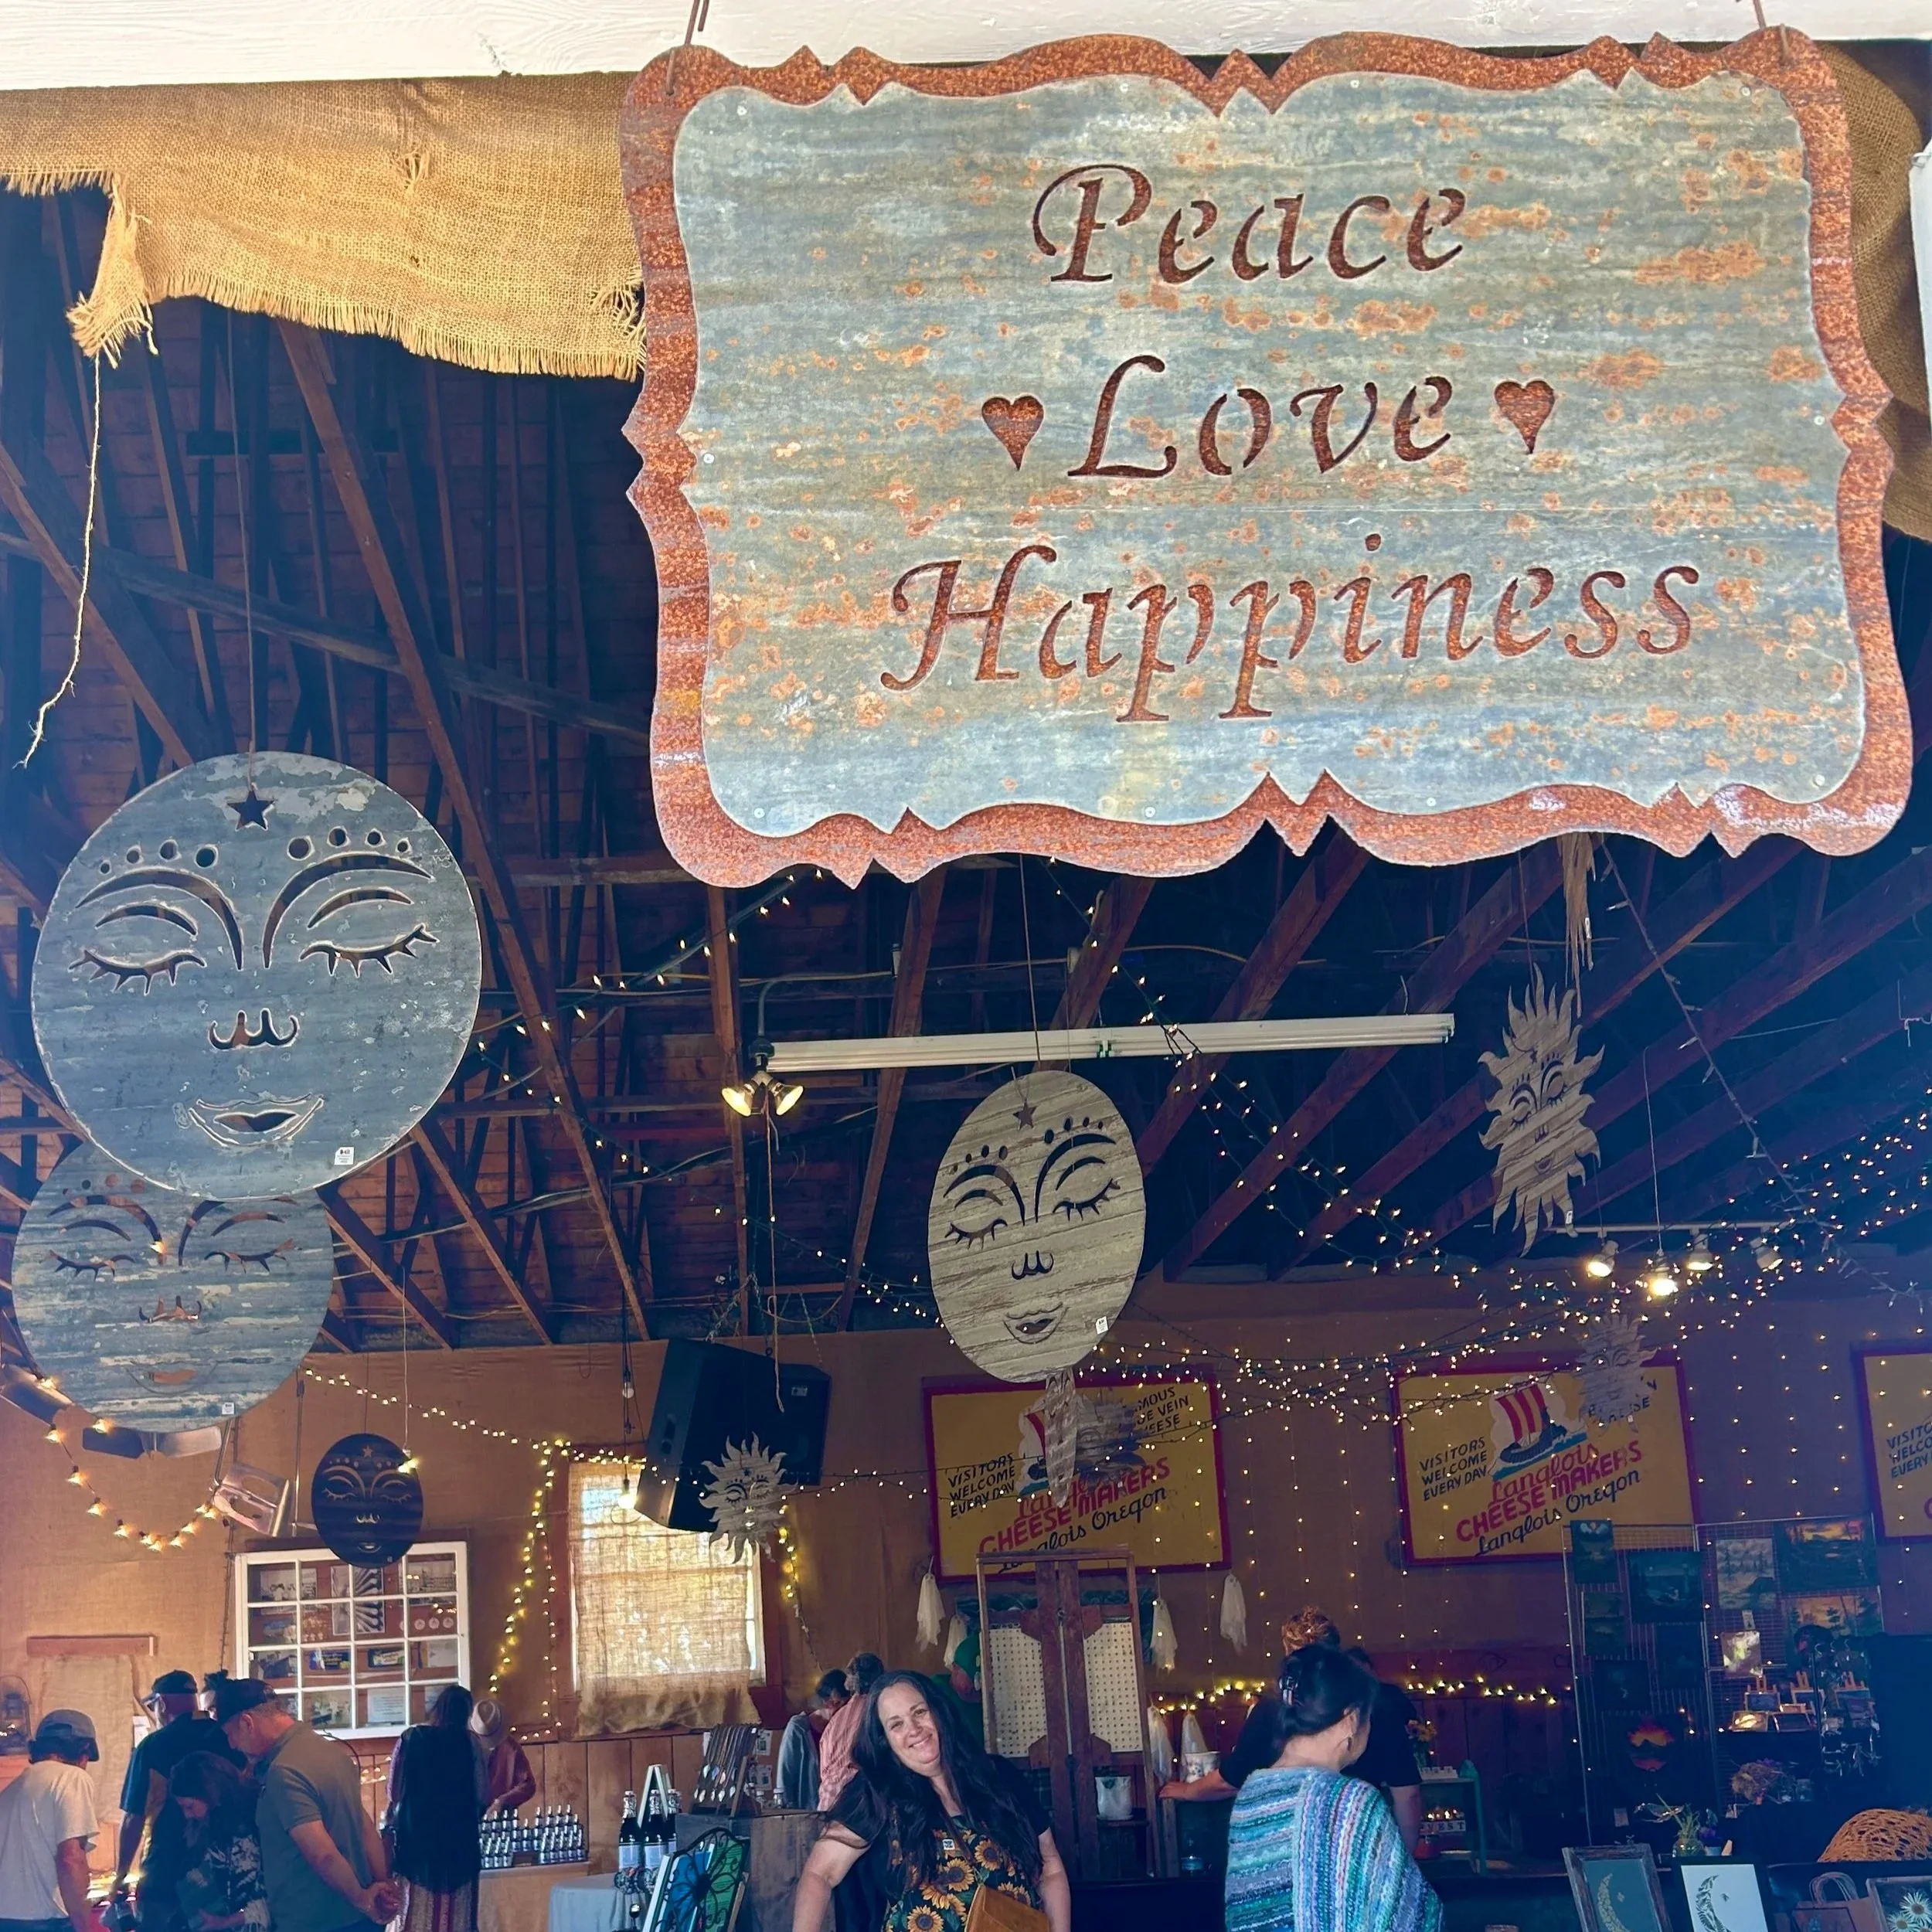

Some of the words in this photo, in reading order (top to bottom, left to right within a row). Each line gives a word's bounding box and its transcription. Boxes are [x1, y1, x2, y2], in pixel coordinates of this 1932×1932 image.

[1032, 162, 1468, 284] Peace
[1067, 354, 1453, 479] Love
[880, 532, 1701, 723] Happiness
[1135, 1387, 1175, 1412] MOUS
[1158, 1396, 1189, 1416] VEIN
[1419, 1437, 1485, 1471] VISITORS
[1886, 1422, 1932, 1450] VISITO
[1889, 1436, 1932, 1464] WELCO
[947, 1453, 1014, 1488] VISITORS
[949, 1466, 1015, 1502] WELCOME
[1422, 1451, 1487, 1485] WELCOME
[1423, 1475, 1461, 1502] EVERY
[1464, 1465, 1487, 1486] DAY
[1488, 1443, 1599, 1508] Langlois
[1891, 1452, 1928, 1479] EVERY
[951, 1492, 989, 1519] EVERY
[992, 1480, 1015, 1501] DAY
[979, 1501, 1073, 1553] CHEESE
[1078, 1457, 1171, 1519] MAKERS
[1091, 1487, 1168, 1530] Oregon
[1456, 1485, 1546, 1542] CHEESE
[1552, 1440, 1642, 1501] MAKERS
[1475, 1509, 1562, 1557] Langlois
[1566, 1470, 1640, 1513] Oregon
